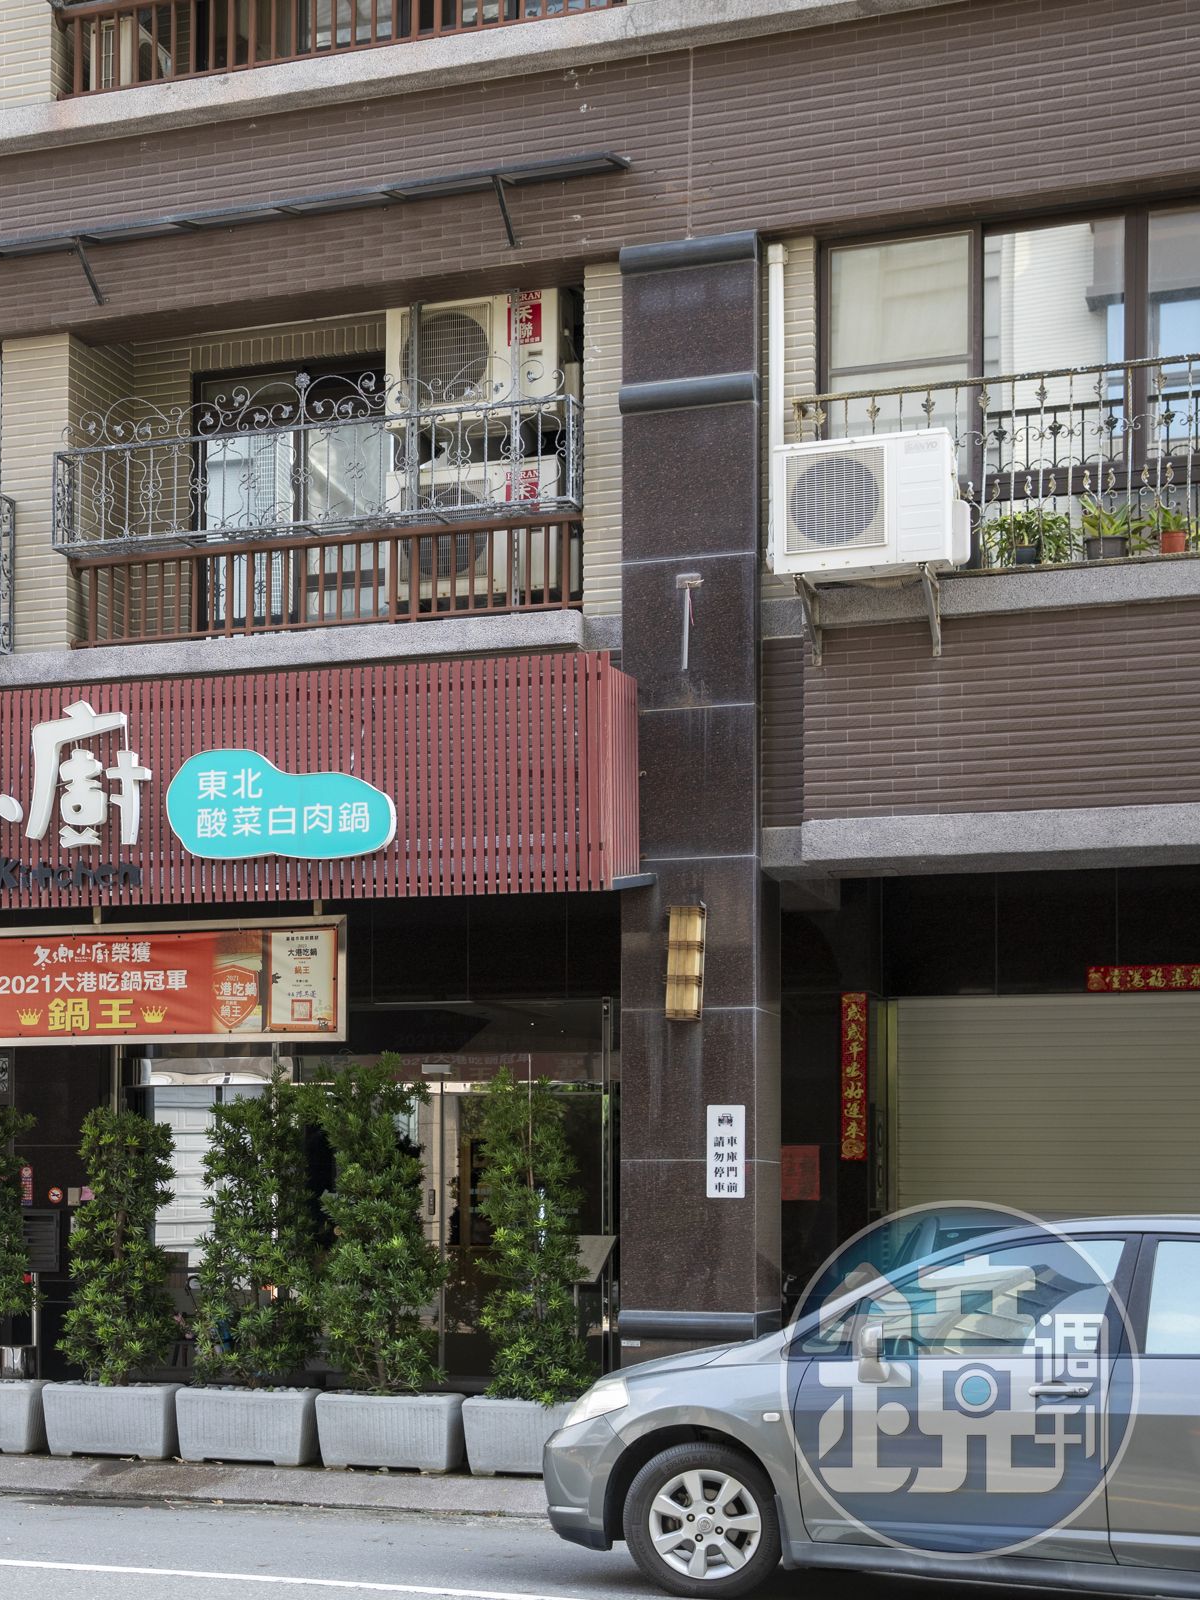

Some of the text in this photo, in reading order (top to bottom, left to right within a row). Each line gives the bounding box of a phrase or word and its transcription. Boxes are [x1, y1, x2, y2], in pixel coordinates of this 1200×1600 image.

[508, 291, 541, 304] RAN
[197, 768, 263, 800] 東北
[196, 802, 370, 838] 酸菜白肉鍋
[48, 998, 137, 1032] 鍋王
[714, 1136, 725, 1193] 請勿停車
[727, 1136, 738, 1193] 車庫門前
